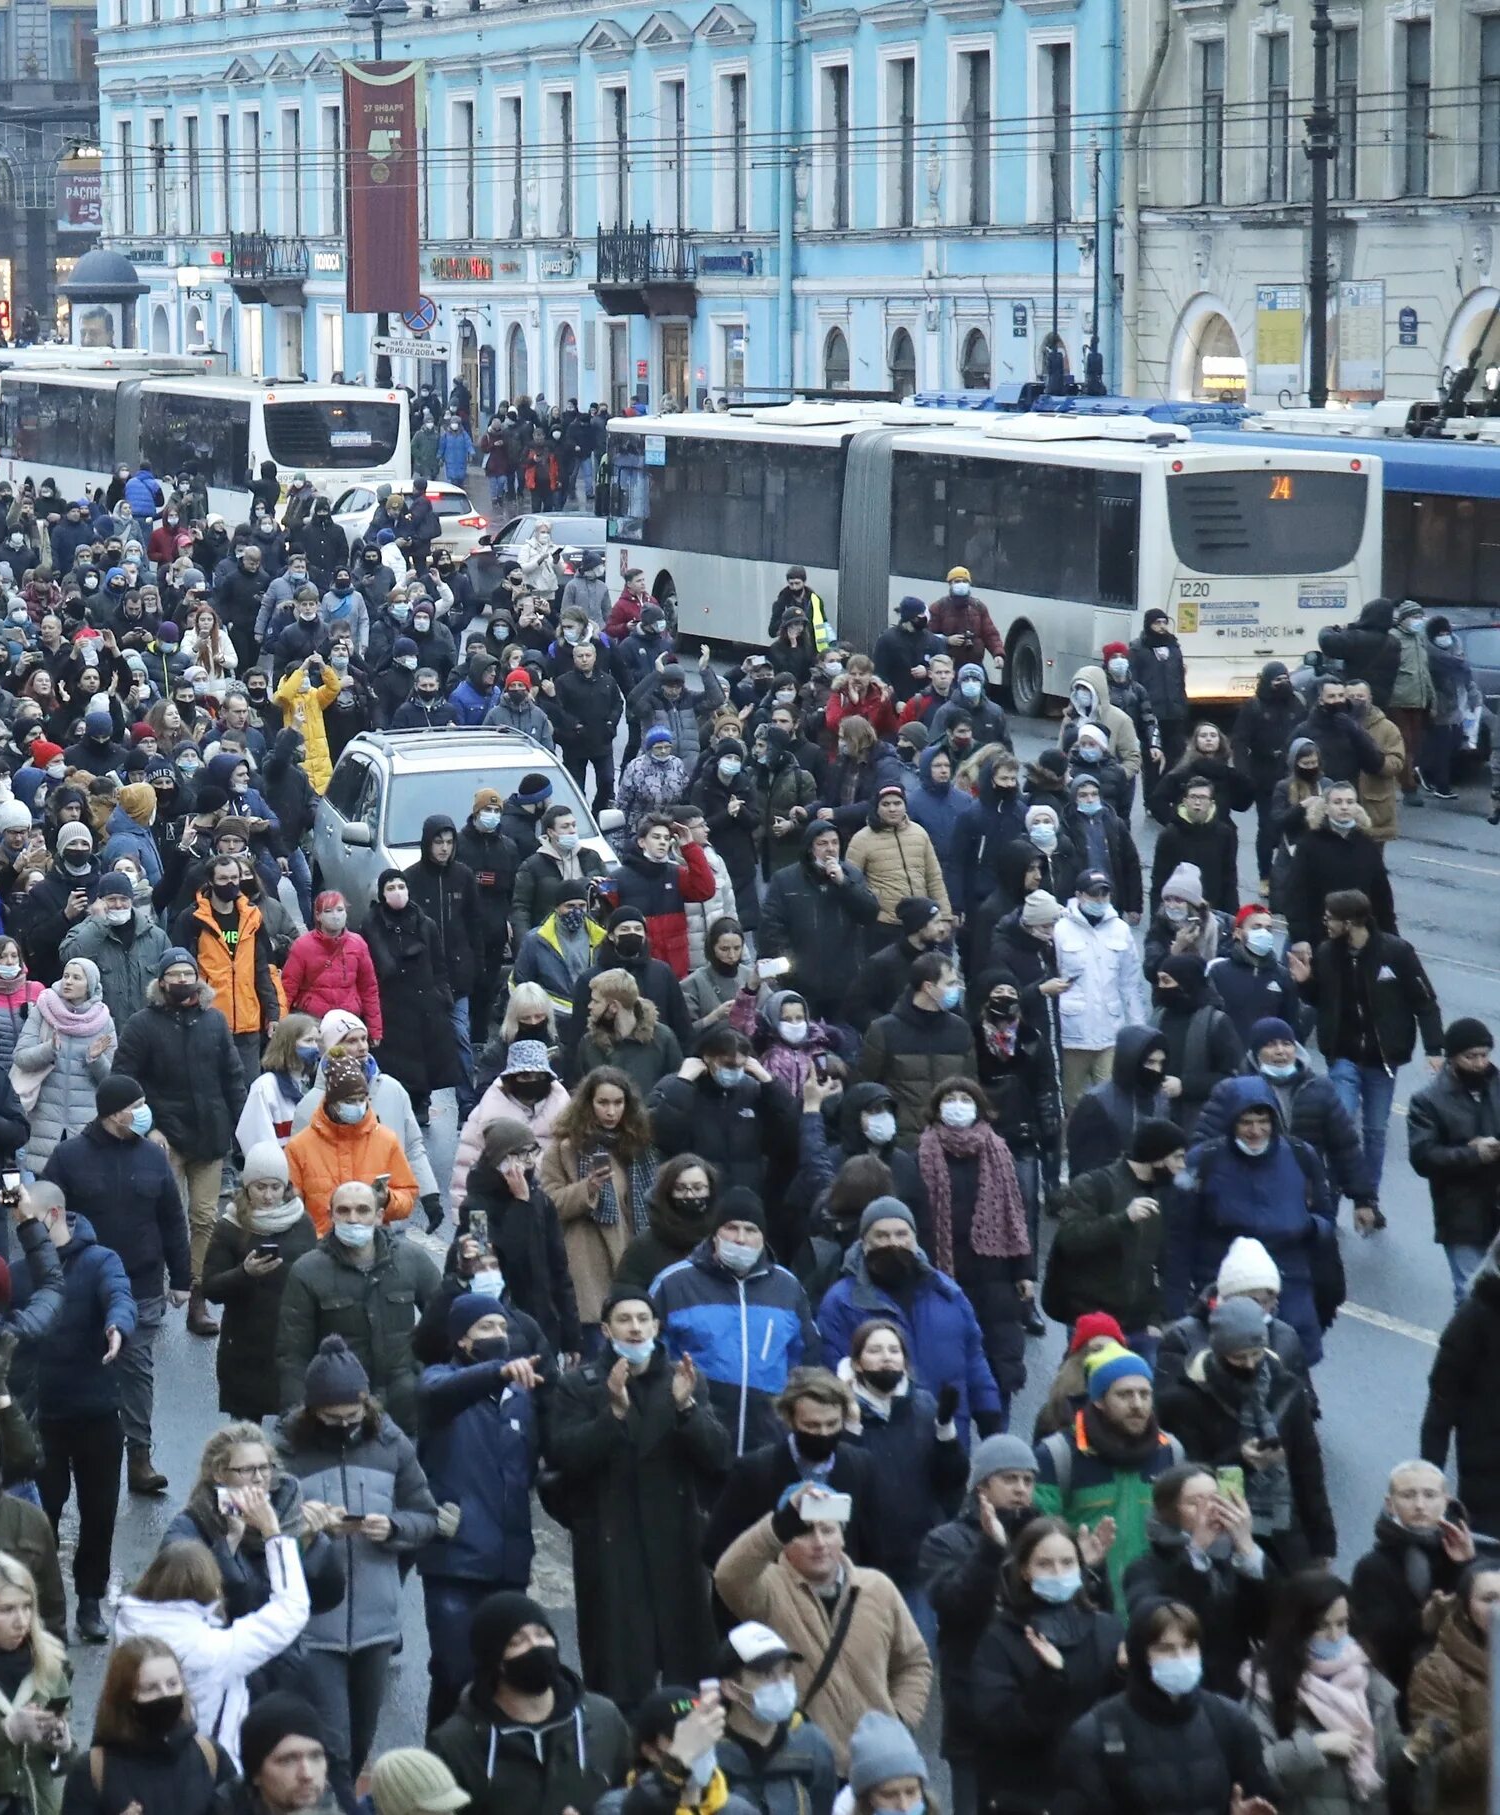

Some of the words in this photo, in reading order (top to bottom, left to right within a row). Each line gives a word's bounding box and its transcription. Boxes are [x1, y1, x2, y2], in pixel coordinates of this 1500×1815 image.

[374, 103, 404, 112] ЯНВАРЯ
[374, 115, 395, 124] 1944
[385, 346, 435, 357] ГРИБОЕДОВА
[1269, 476, 1292, 500] 24
[1179, 582, 1210, 597] 1220
[1241, 626, 1279, 638] ВЫНОС
